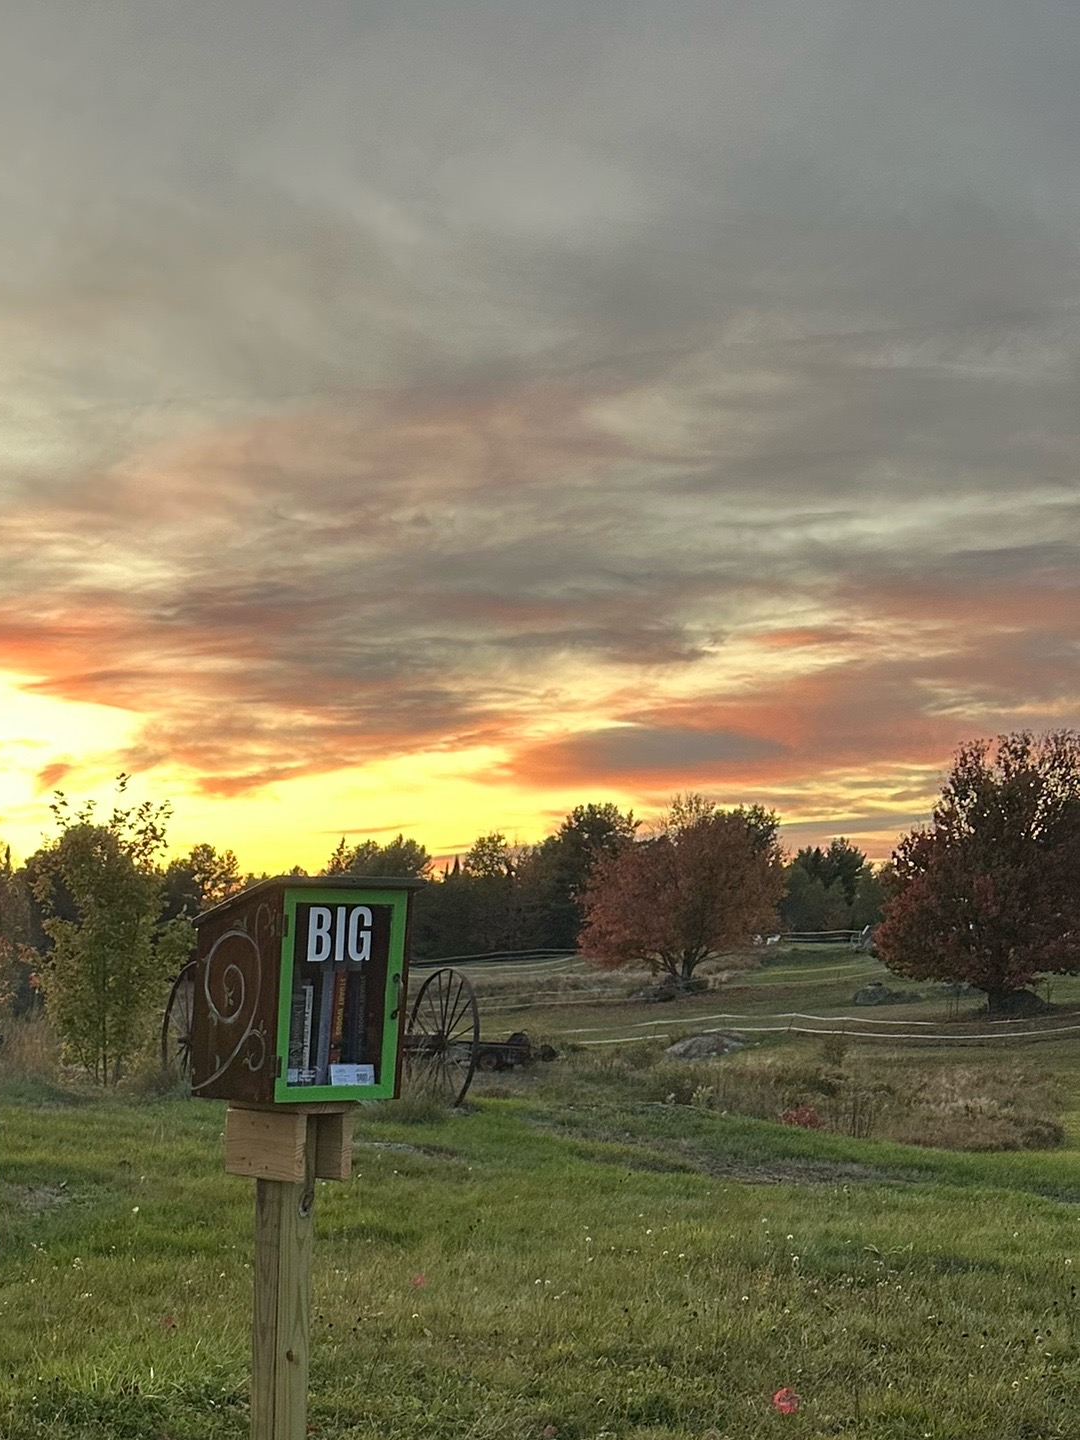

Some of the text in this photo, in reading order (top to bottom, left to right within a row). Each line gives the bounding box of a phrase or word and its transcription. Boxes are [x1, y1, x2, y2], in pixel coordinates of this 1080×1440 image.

[306, 905, 373, 962] BIG
[335, 977, 347, 1036] STUART WOODS
[357, 974, 367, 1035] STUART WOODS
